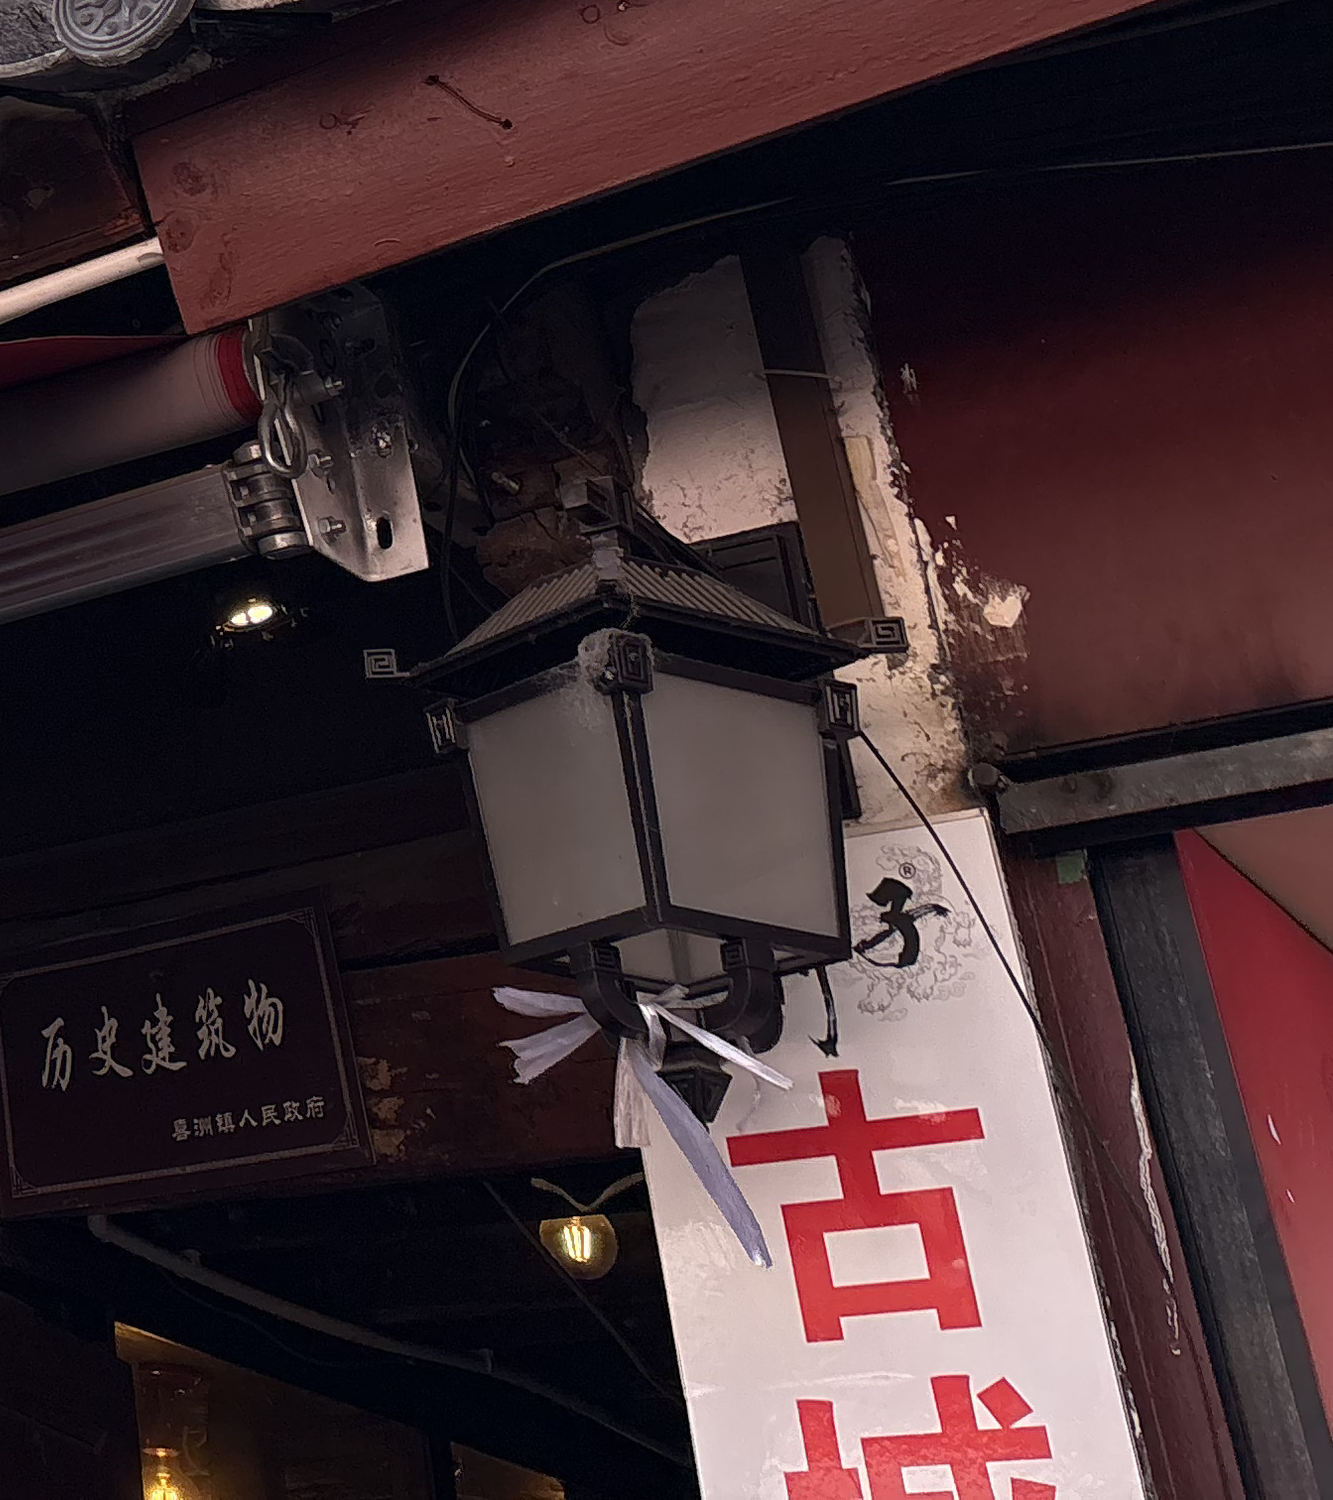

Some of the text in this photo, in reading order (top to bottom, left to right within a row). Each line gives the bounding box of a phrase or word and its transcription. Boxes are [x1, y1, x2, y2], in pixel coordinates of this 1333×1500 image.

[40, 978, 286, 1092] 历史建筑物
[171, 1095, 326, 1142] 喜洲镇人民政府
